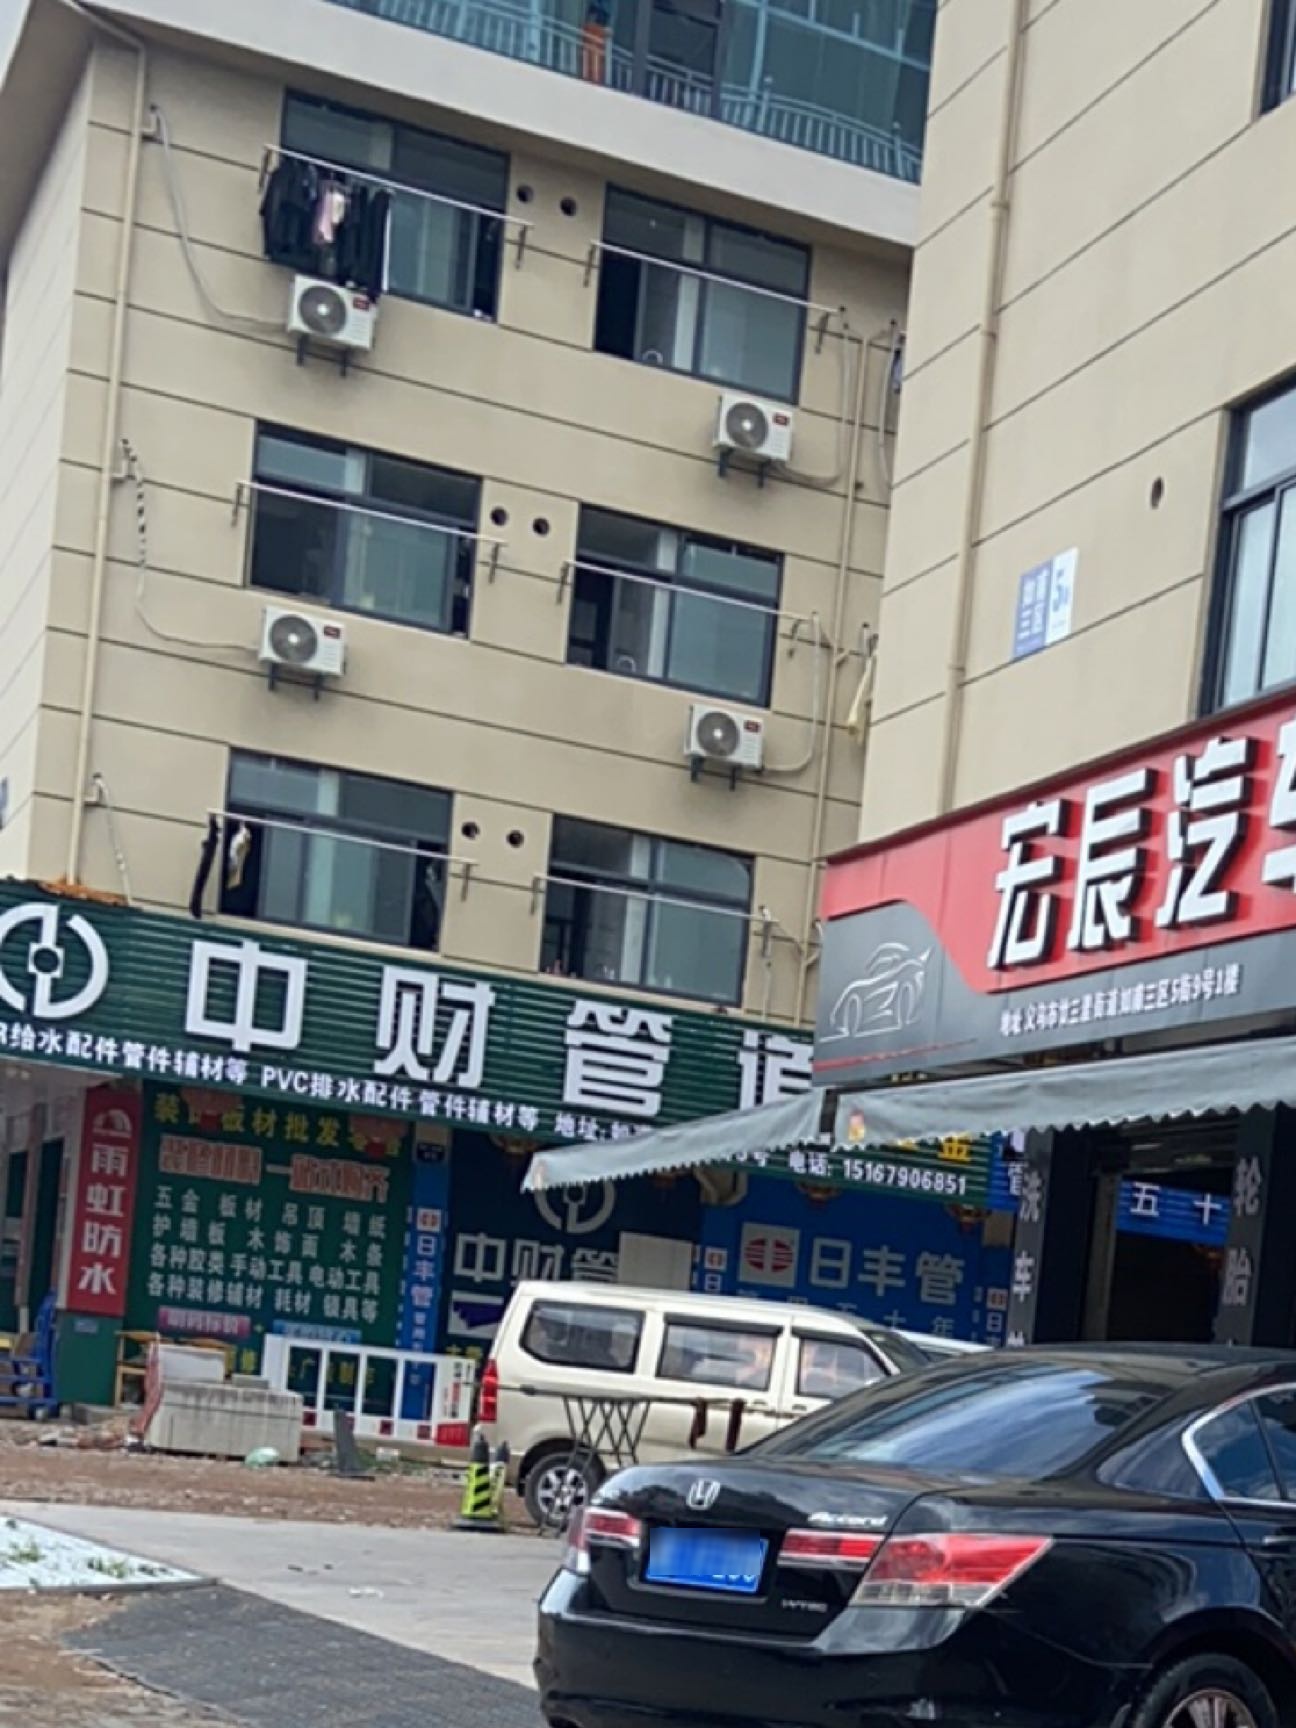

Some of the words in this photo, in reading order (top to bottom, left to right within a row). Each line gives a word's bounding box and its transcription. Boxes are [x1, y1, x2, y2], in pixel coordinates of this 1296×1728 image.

[154, 1184, 201, 1214] 五金
[843, 1158, 966, 1196] 15167906851
[77, 1143, 130, 1296] 雨虹防水
[229, 1252, 304, 1285] 手动工具
[308, 1264, 382, 1296] 电动工具
[809, 1236, 966, 1306] 日丰管
